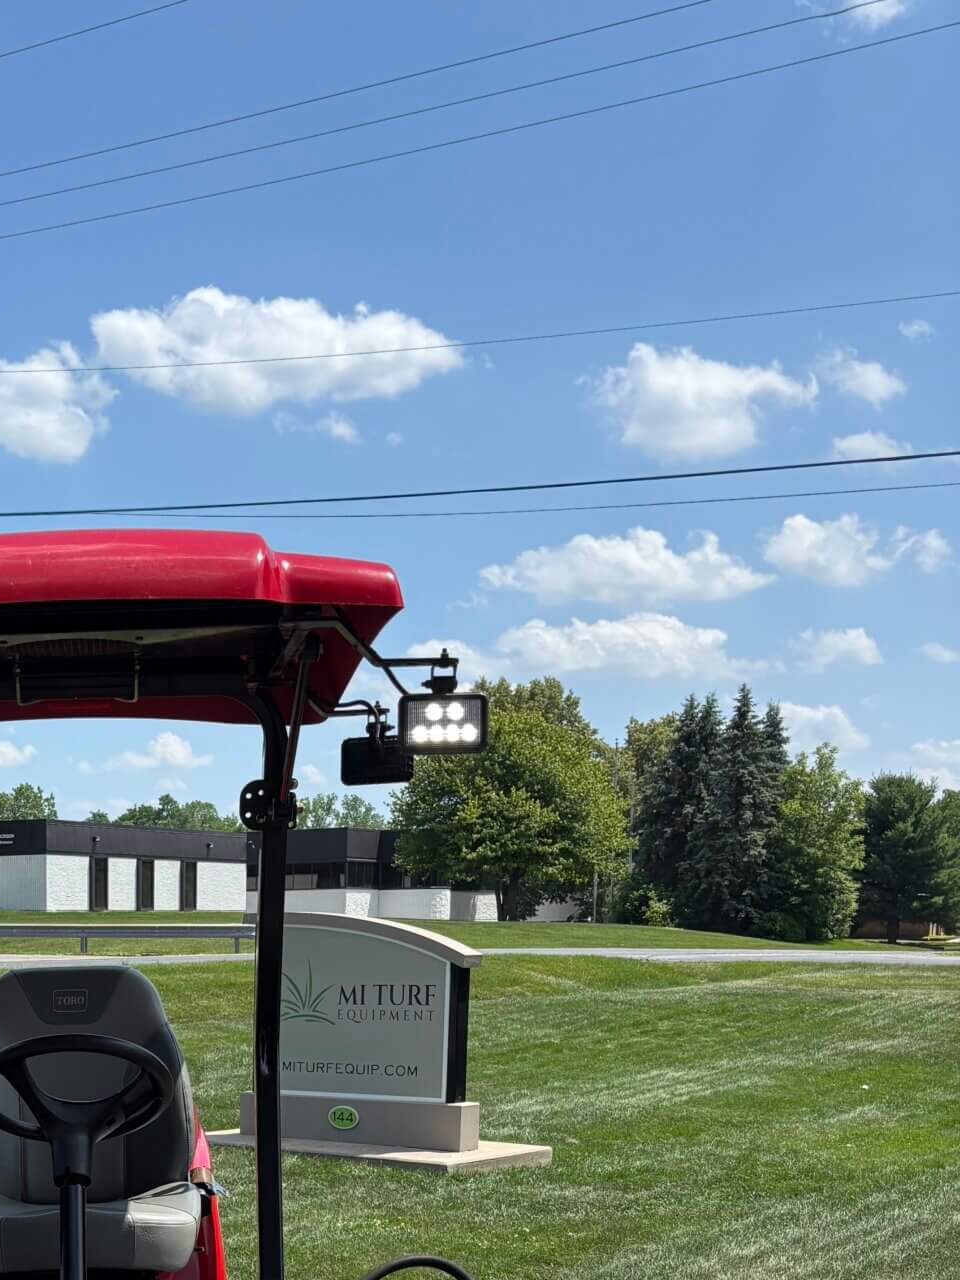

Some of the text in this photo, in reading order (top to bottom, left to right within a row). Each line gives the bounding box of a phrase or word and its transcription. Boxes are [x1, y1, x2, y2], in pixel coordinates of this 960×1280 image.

[56, 996, 85, 1006] TORO
[339, 984, 437, 1006] MI TURF
[337, 1008, 436, 1024] EQUIPMENT
[281, 1061, 419, 1078] MITURFEQUIP.COM
[333, 1111, 354, 1123] 144
